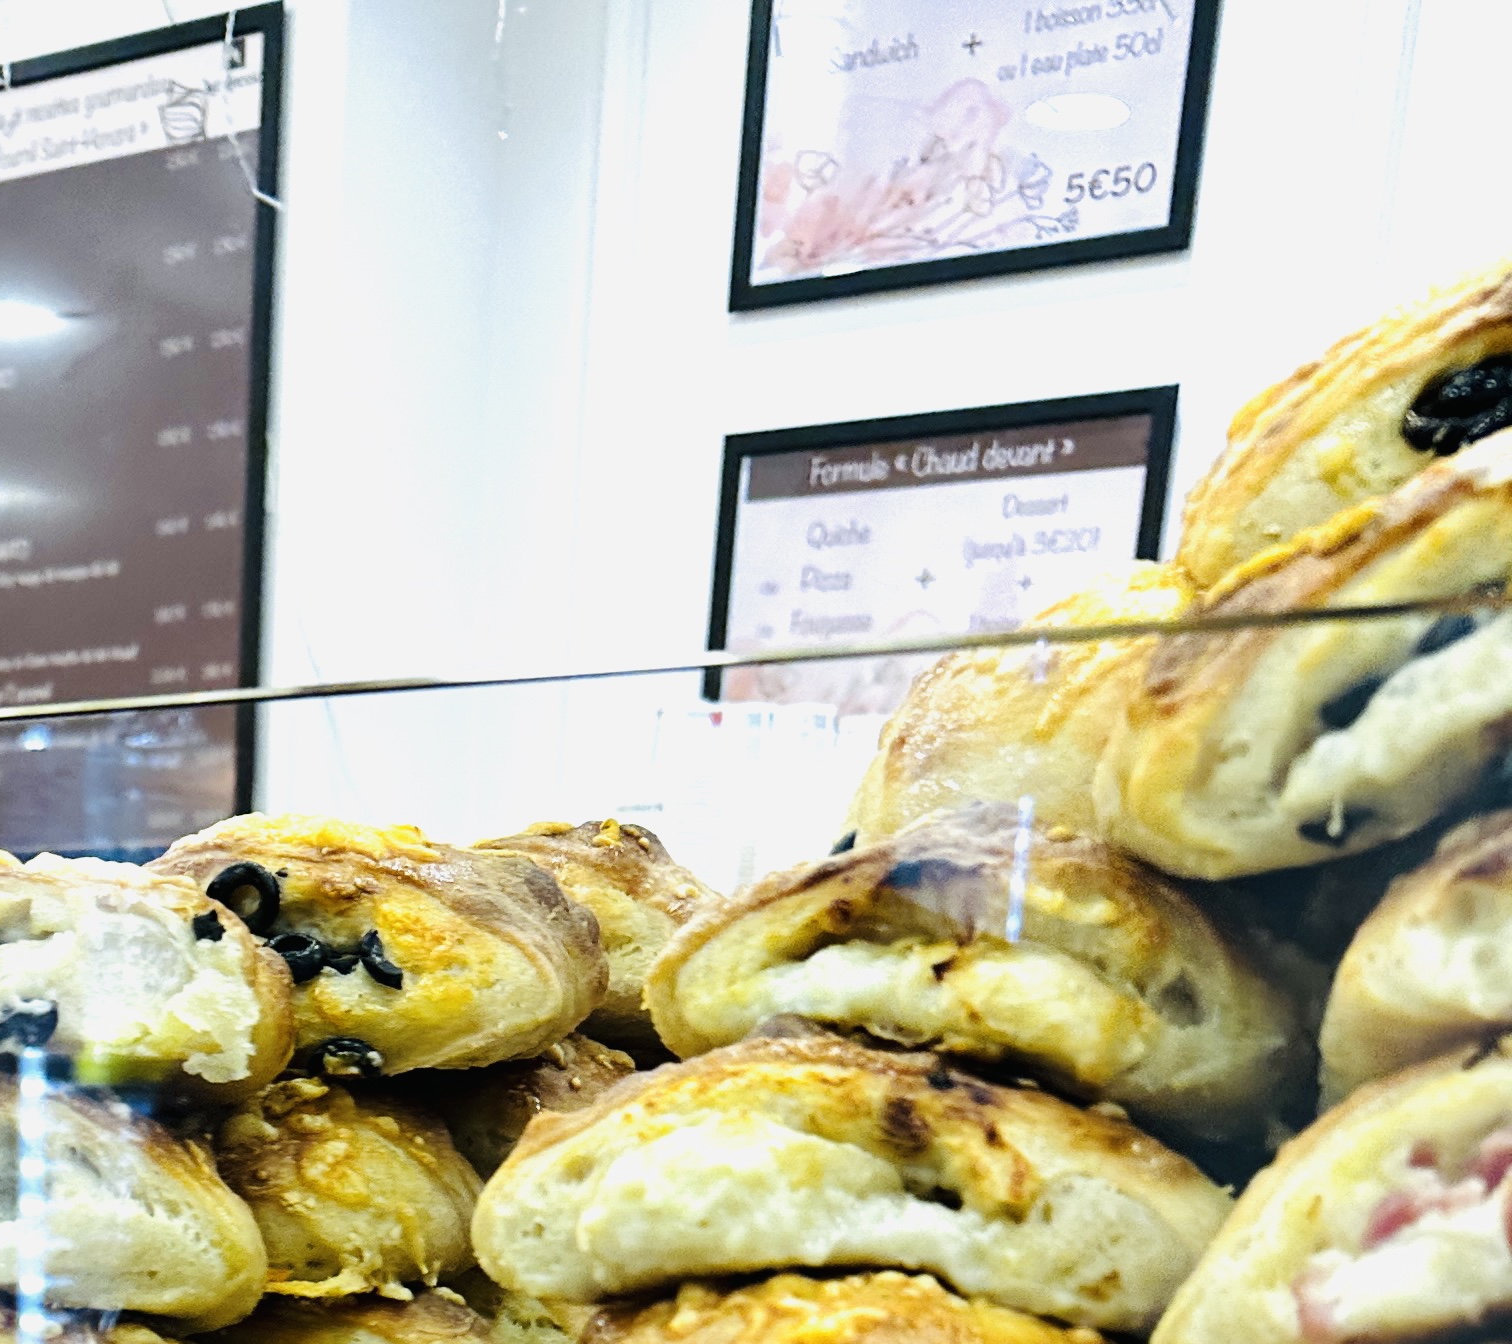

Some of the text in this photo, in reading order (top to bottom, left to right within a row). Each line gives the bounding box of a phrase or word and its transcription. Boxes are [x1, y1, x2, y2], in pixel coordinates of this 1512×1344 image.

[1063, 162, 1158, 205] 5€50
[810, 452, 891, 487] Formule
[911, 442, 980, 478] Chaud
[982, 437, 1056, 471] devant
[806, 518, 872, 549] Quiche
